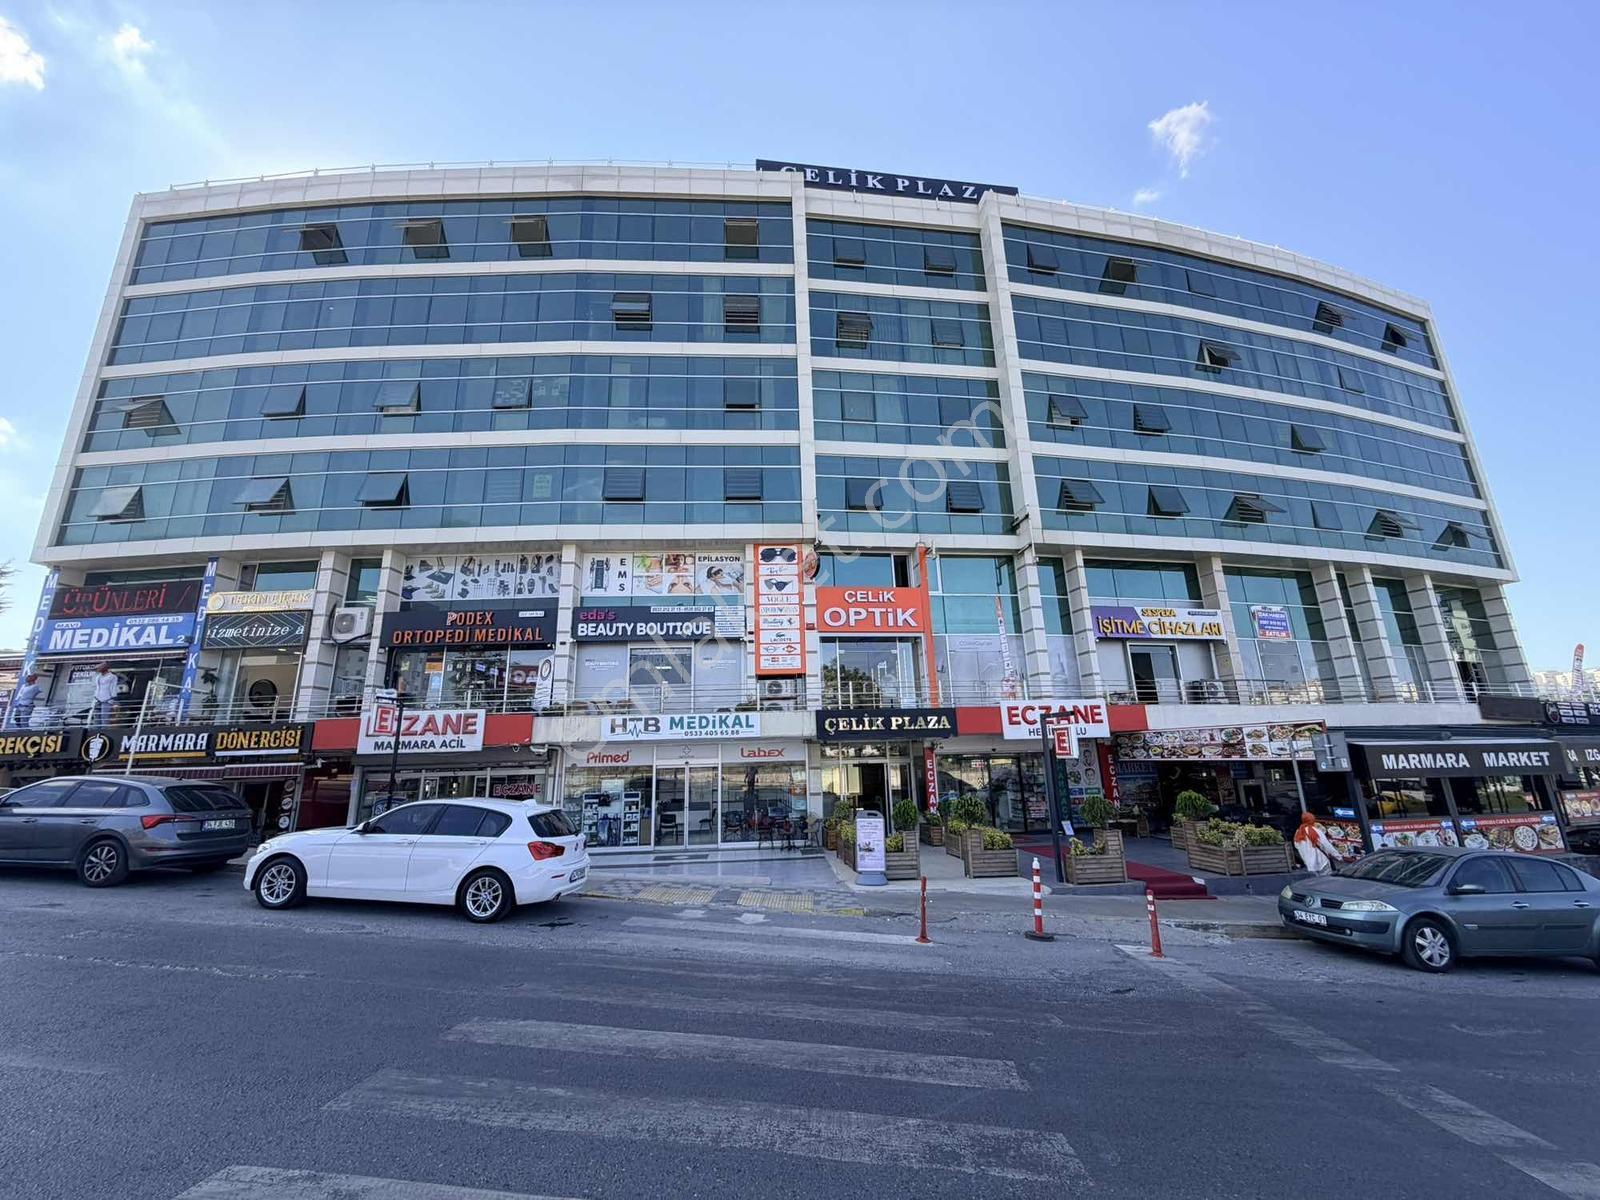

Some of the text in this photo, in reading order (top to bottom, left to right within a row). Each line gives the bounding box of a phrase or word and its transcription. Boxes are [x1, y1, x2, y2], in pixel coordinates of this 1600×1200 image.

[697, 554, 741, 564] EPİLASYON
[446, 611, 495, 626] PODEX
[1097, 615, 1222, 637] İŞİTME CİHAZLARI
[49, 622, 185, 650] MEDİKAL 2
[393, 625, 543, 644] ORTOPEDİ MEDİKAL
[577, 622, 635, 637] BEAUTY
[637, 621, 712, 637] BOUTIQUE
[610, 716, 661, 736] HTB
[824, 712, 951, 735] ÇELİK PLAZA
[120, 732, 209, 752] MARMARA
[439, 738, 467, 750] ACİL
[586, 750, 631, 764] Primed
[1381, 751, 1550, 771] MARMARA MARKET
[493, 783, 542, 796] ECZANE
